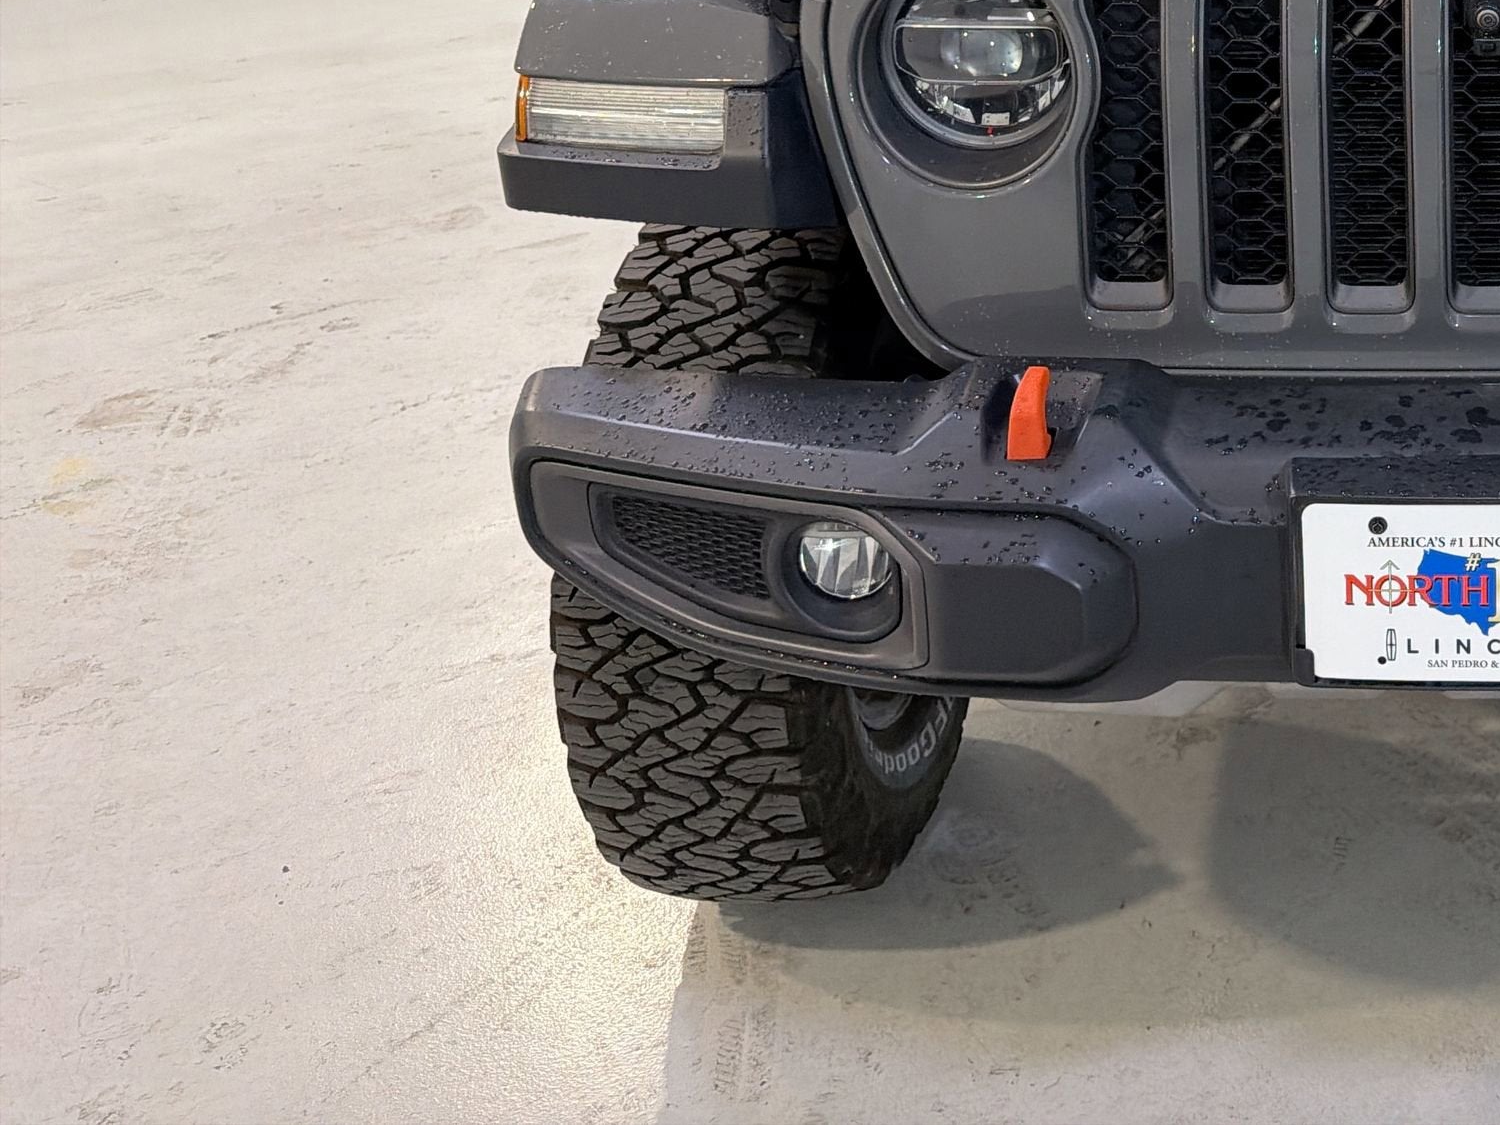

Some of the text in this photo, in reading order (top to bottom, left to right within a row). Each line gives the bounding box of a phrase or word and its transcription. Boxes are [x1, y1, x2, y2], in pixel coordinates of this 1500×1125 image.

[1366, 536, 1446, 548] AMERICA'S
[1449, 537, 1464, 548] #1
[1343, 574, 1490, 607] NORTH
[1427, 659, 1449, 668] SAN
[1452, 659, 1488, 669] PEDRO
[1490, 659, 1500, 669] &
